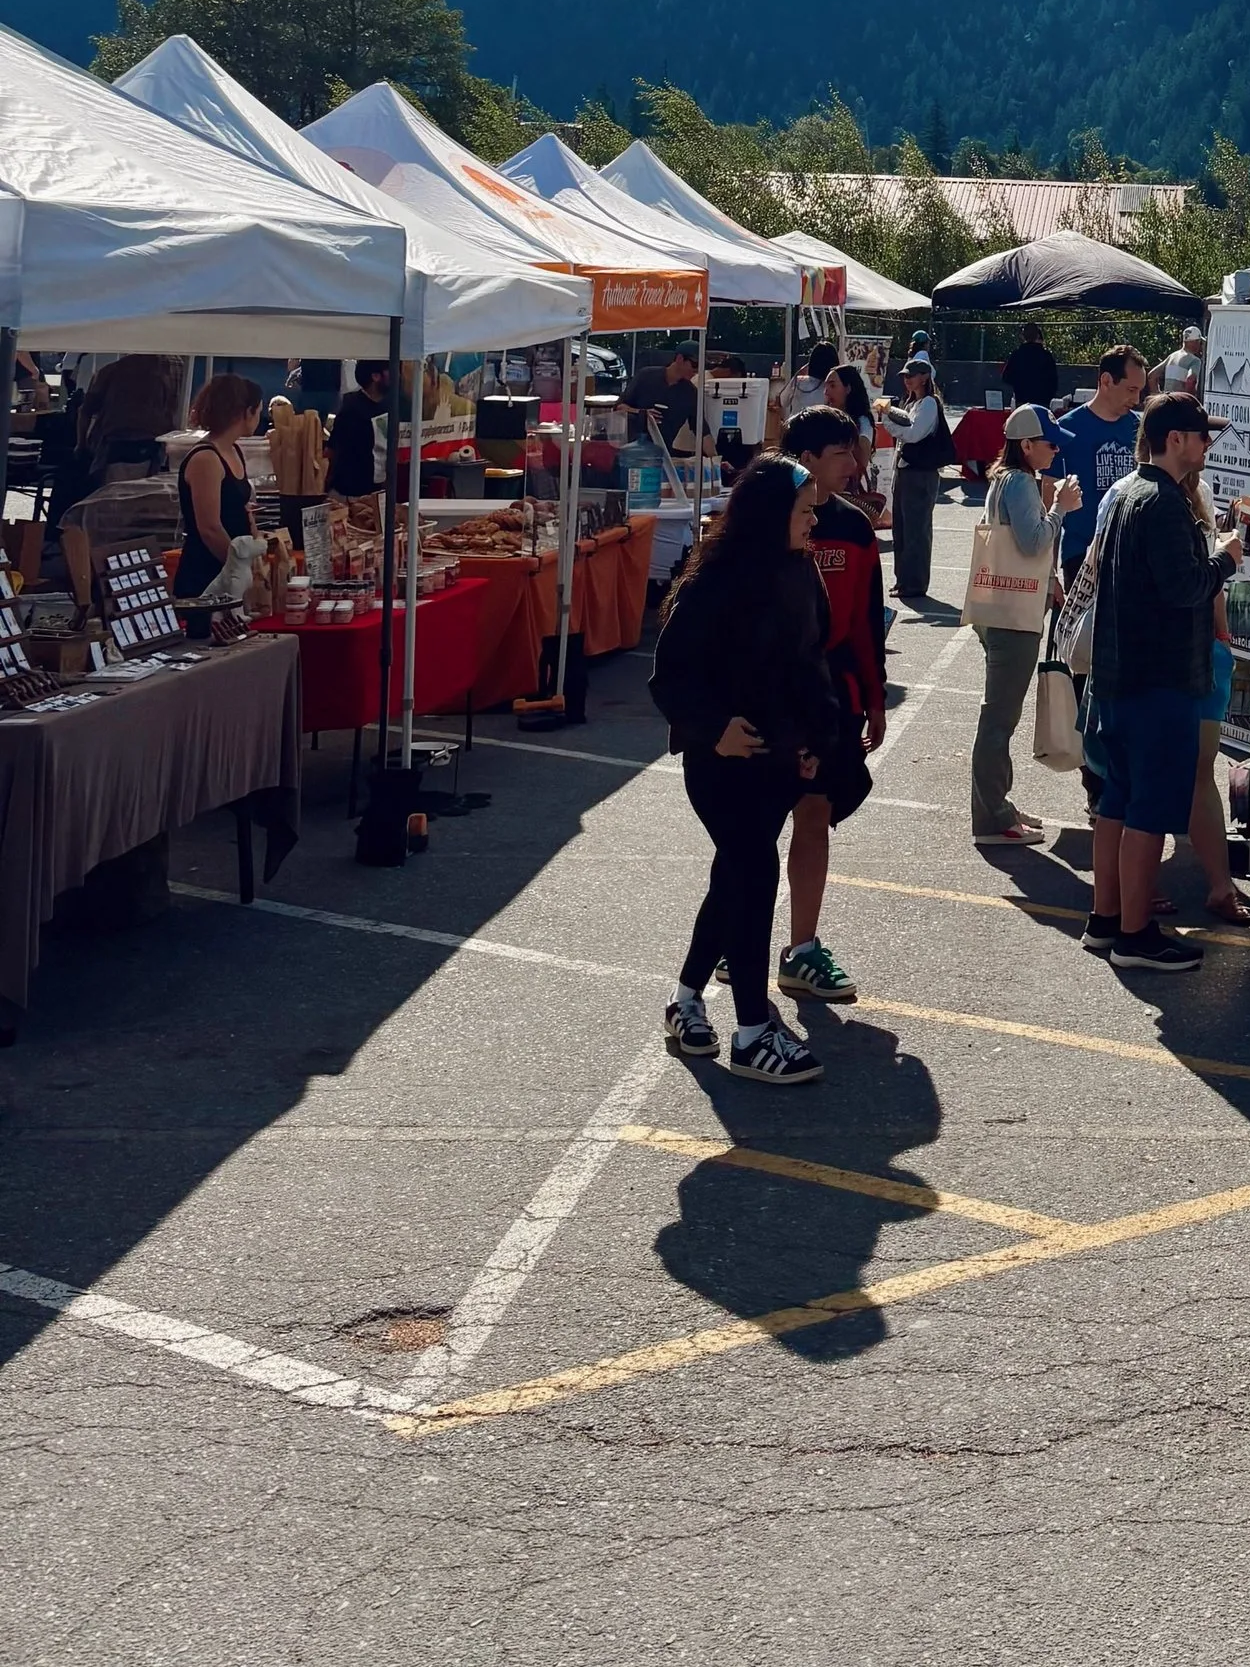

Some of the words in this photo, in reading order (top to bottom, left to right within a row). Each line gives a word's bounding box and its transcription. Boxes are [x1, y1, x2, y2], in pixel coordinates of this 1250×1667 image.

[602, 278, 641, 311] Authentic
[640, 279, 665, 308] French
[663, 280, 689, 314] Bakery
[1096, 453, 1113, 466] LIVE
[1114, 454, 1134, 467] FREE
[1208, 452, 1223, 464] MEAL
[1223, 454, 1238, 466] PREP
[1238, 457, 1250, 469] KITS
[1096, 465, 1114, 477] RIDE
[1096, 476, 1110, 487] GET
